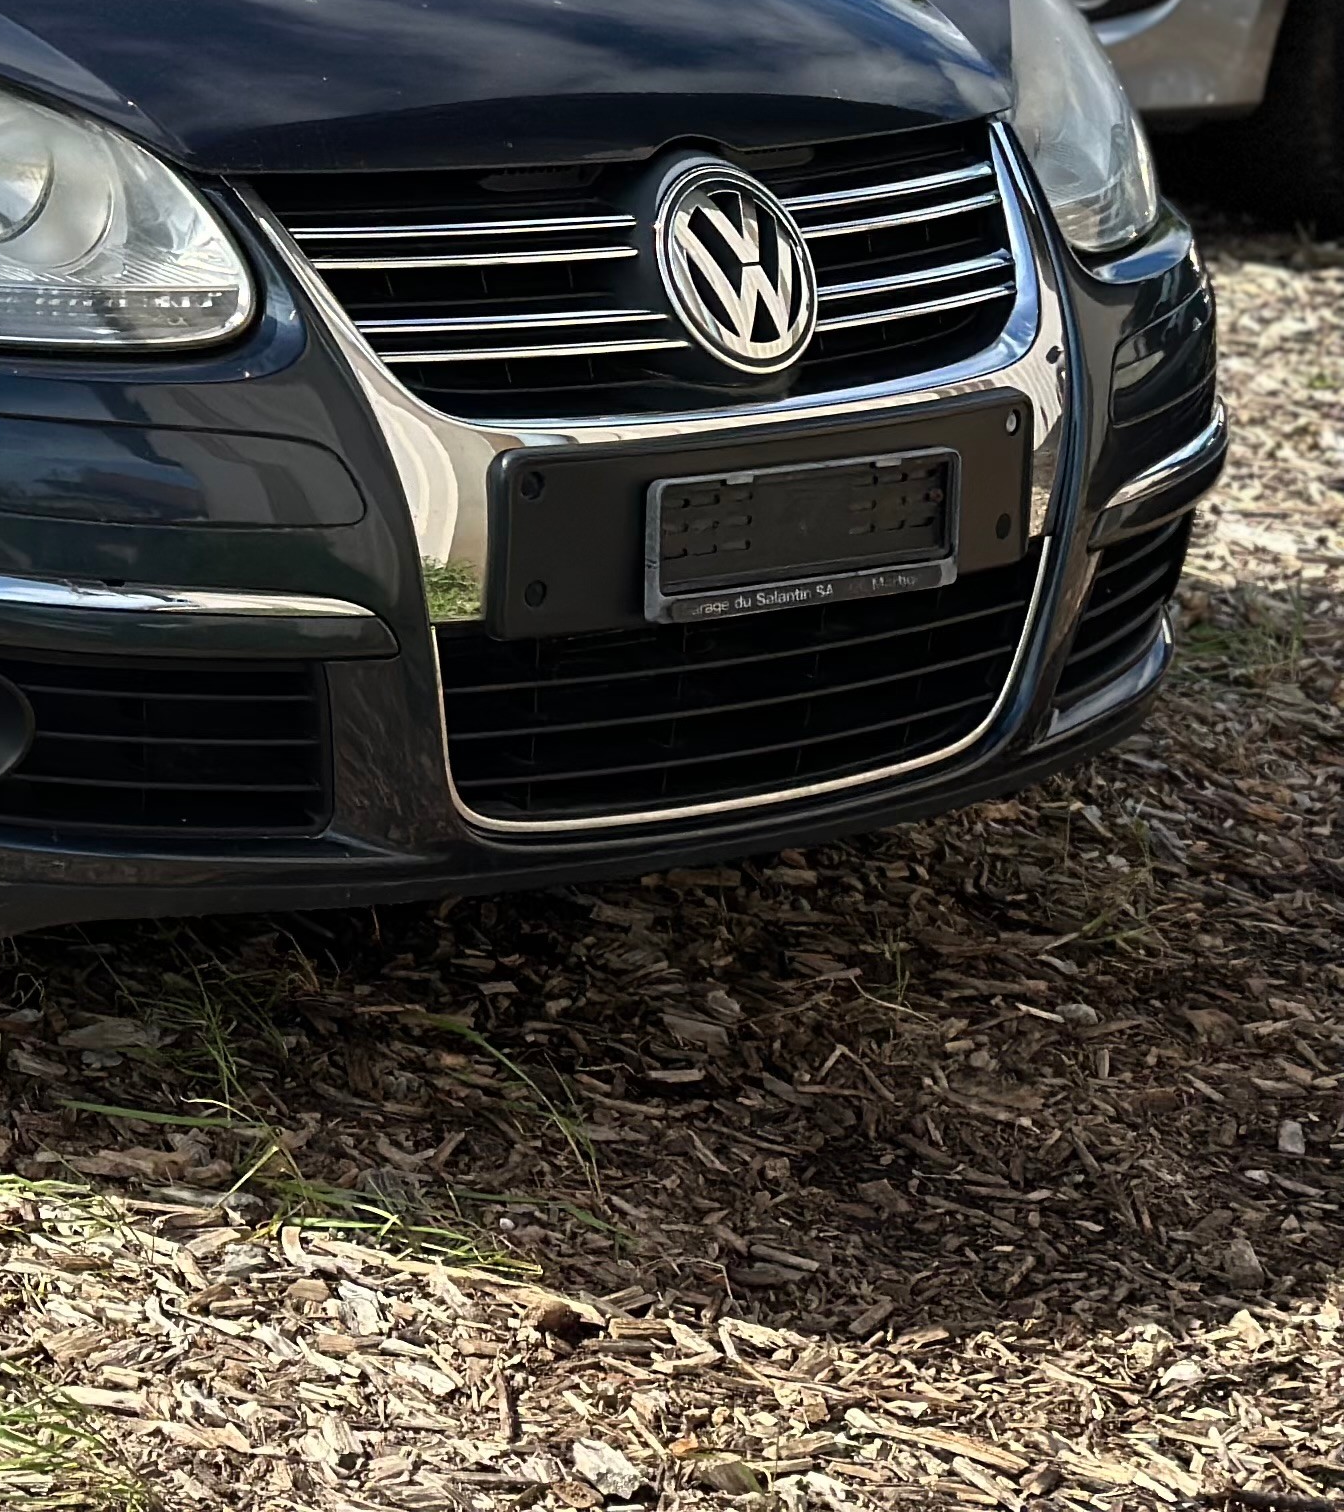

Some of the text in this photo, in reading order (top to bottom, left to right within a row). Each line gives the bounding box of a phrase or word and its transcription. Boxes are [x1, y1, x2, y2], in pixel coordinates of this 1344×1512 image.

[668, 180, 812, 361] VW
[691, 600, 730, 615] arage
[734, 594, 752, 608] du
[755, 587, 812, 607] Salantin
